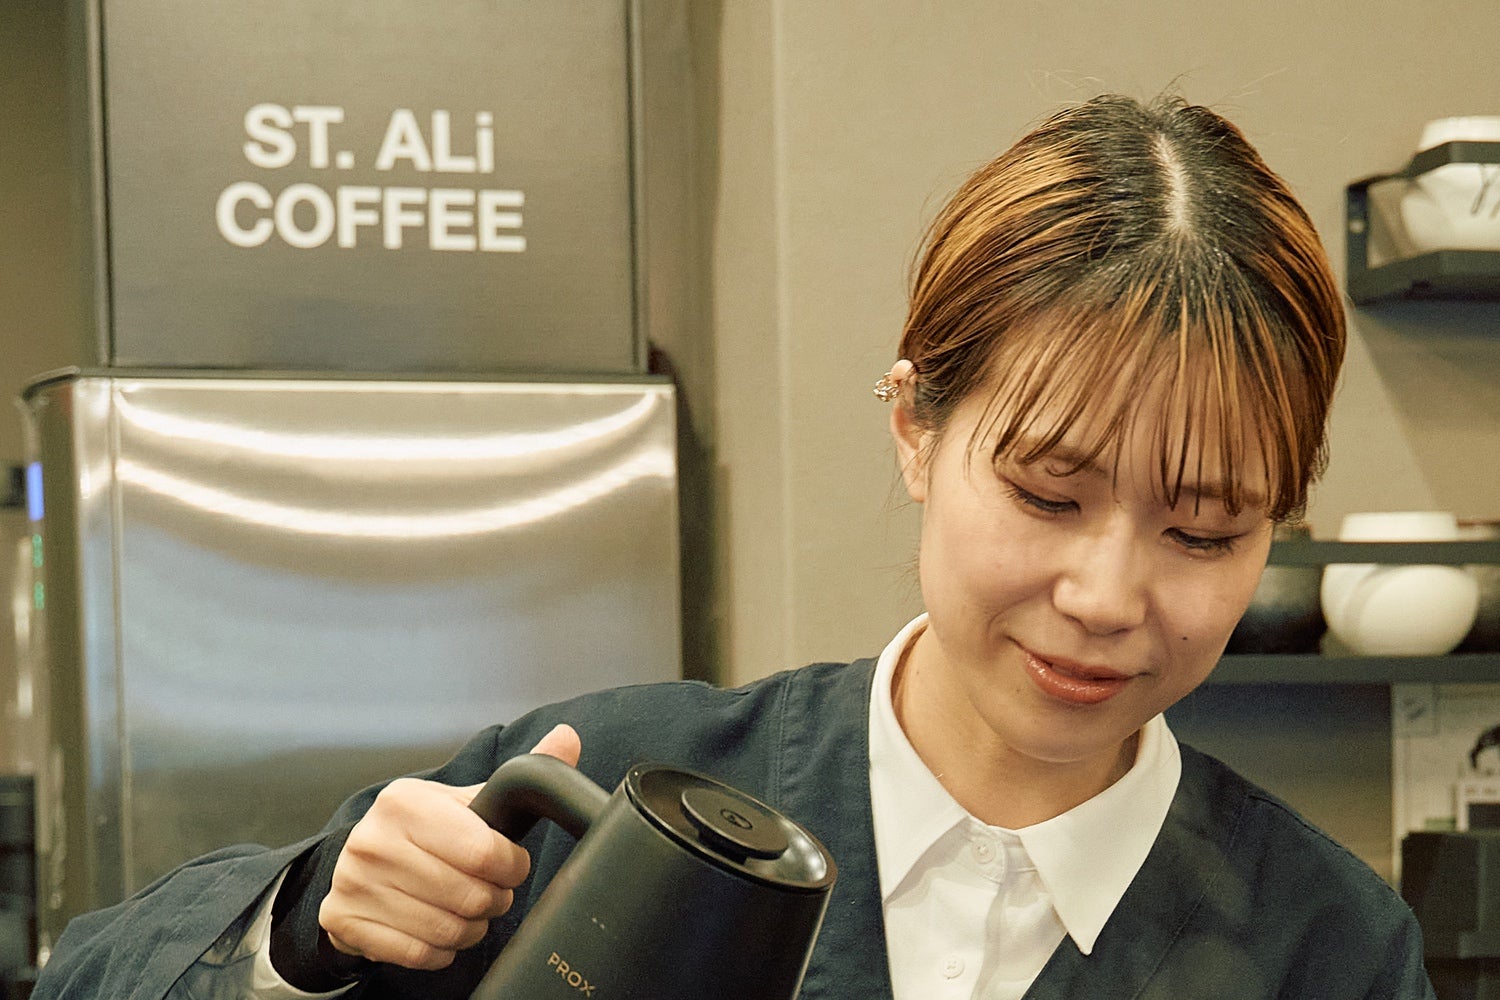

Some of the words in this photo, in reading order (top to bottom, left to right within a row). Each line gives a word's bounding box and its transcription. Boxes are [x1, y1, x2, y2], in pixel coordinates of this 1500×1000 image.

[243, 103, 355, 170] ST.
[376, 106, 495, 174] ALi
[215, 181, 527, 253] COFFEE
[547, 952, 596, 998] PROX
